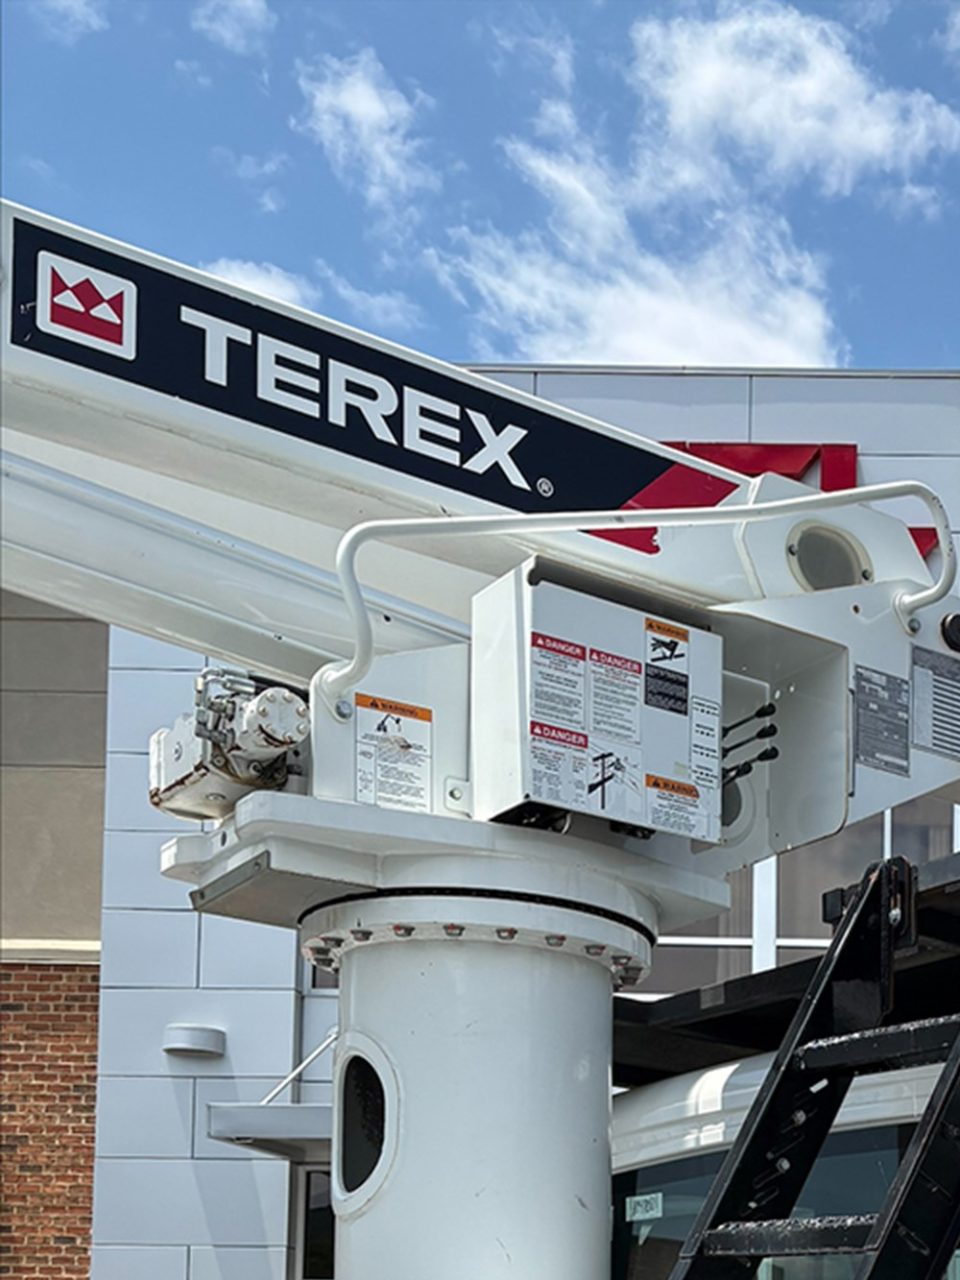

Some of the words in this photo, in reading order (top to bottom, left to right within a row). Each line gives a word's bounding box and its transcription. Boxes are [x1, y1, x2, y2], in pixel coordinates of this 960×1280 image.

[180, 305, 532, 491] TEREX
[545, 640, 581, 656] DANGER
[600, 653, 639, 671] DANGER
[543, 726, 586, 746] DANGER
